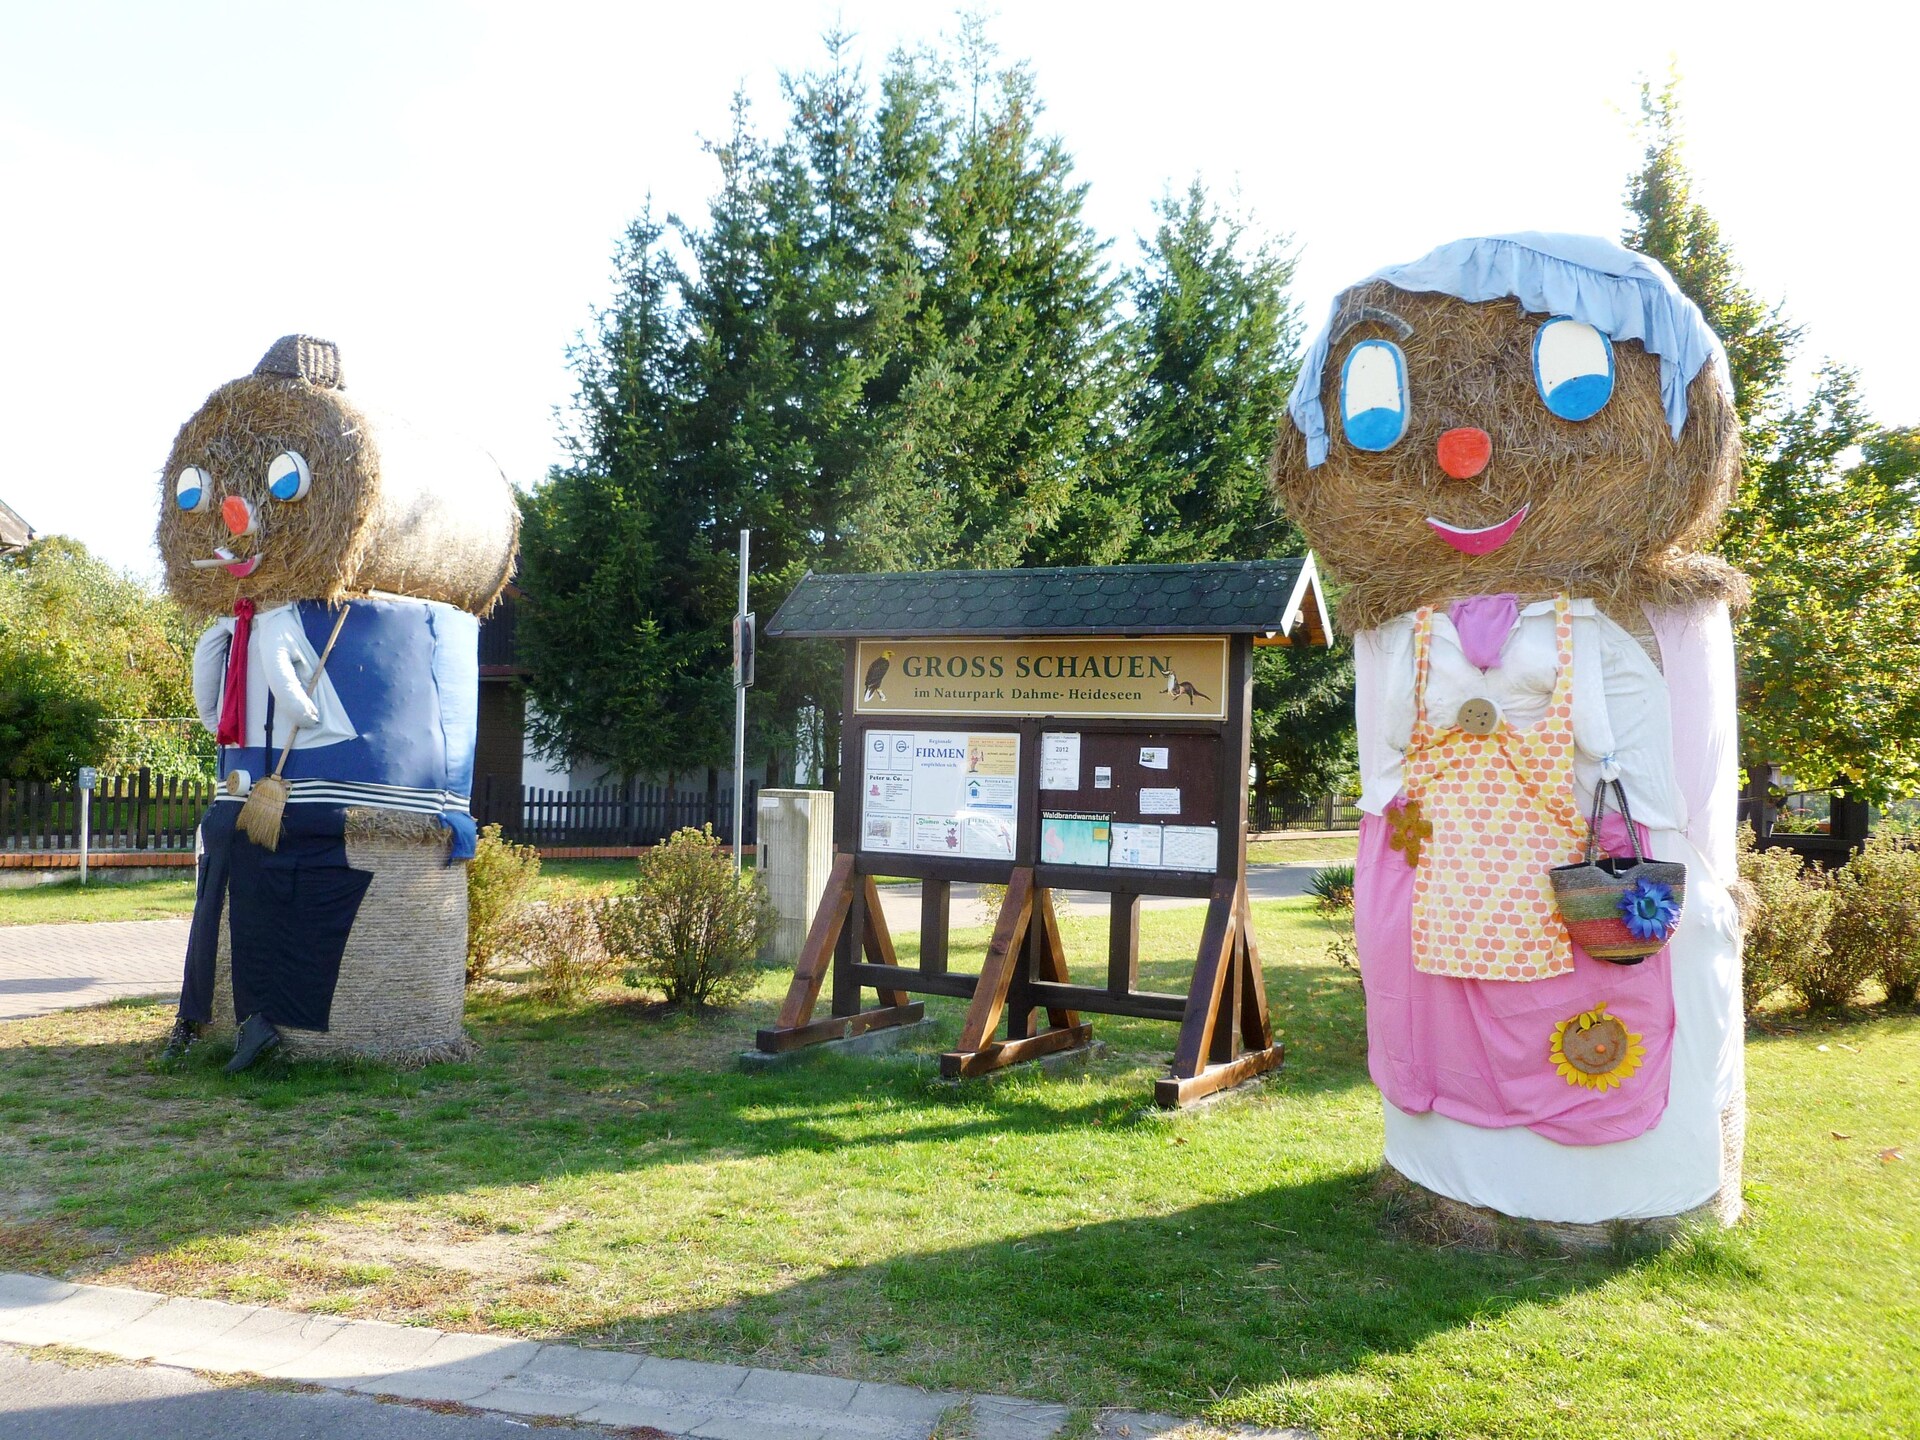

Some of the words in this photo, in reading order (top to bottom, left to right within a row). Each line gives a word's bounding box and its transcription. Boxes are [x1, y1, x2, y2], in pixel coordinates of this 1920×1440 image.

[902, 655, 1004, 678] GROSS
[1015, 655, 1172, 679] SCHAUEN
[914, 687, 930, 698] im
[934, 687, 1004, 702] Naturpark
[1011, 688, 1065, 700] Dahme-
[1068, 688, 1142, 700] Heideseen
[916, 747, 965, 759] FIRMEN
[916, 817, 939, 826] Blumen
[943, 818, 959, 827] Shop
[1042, 811, 1110, 821] Waldbrandwarnstufe
